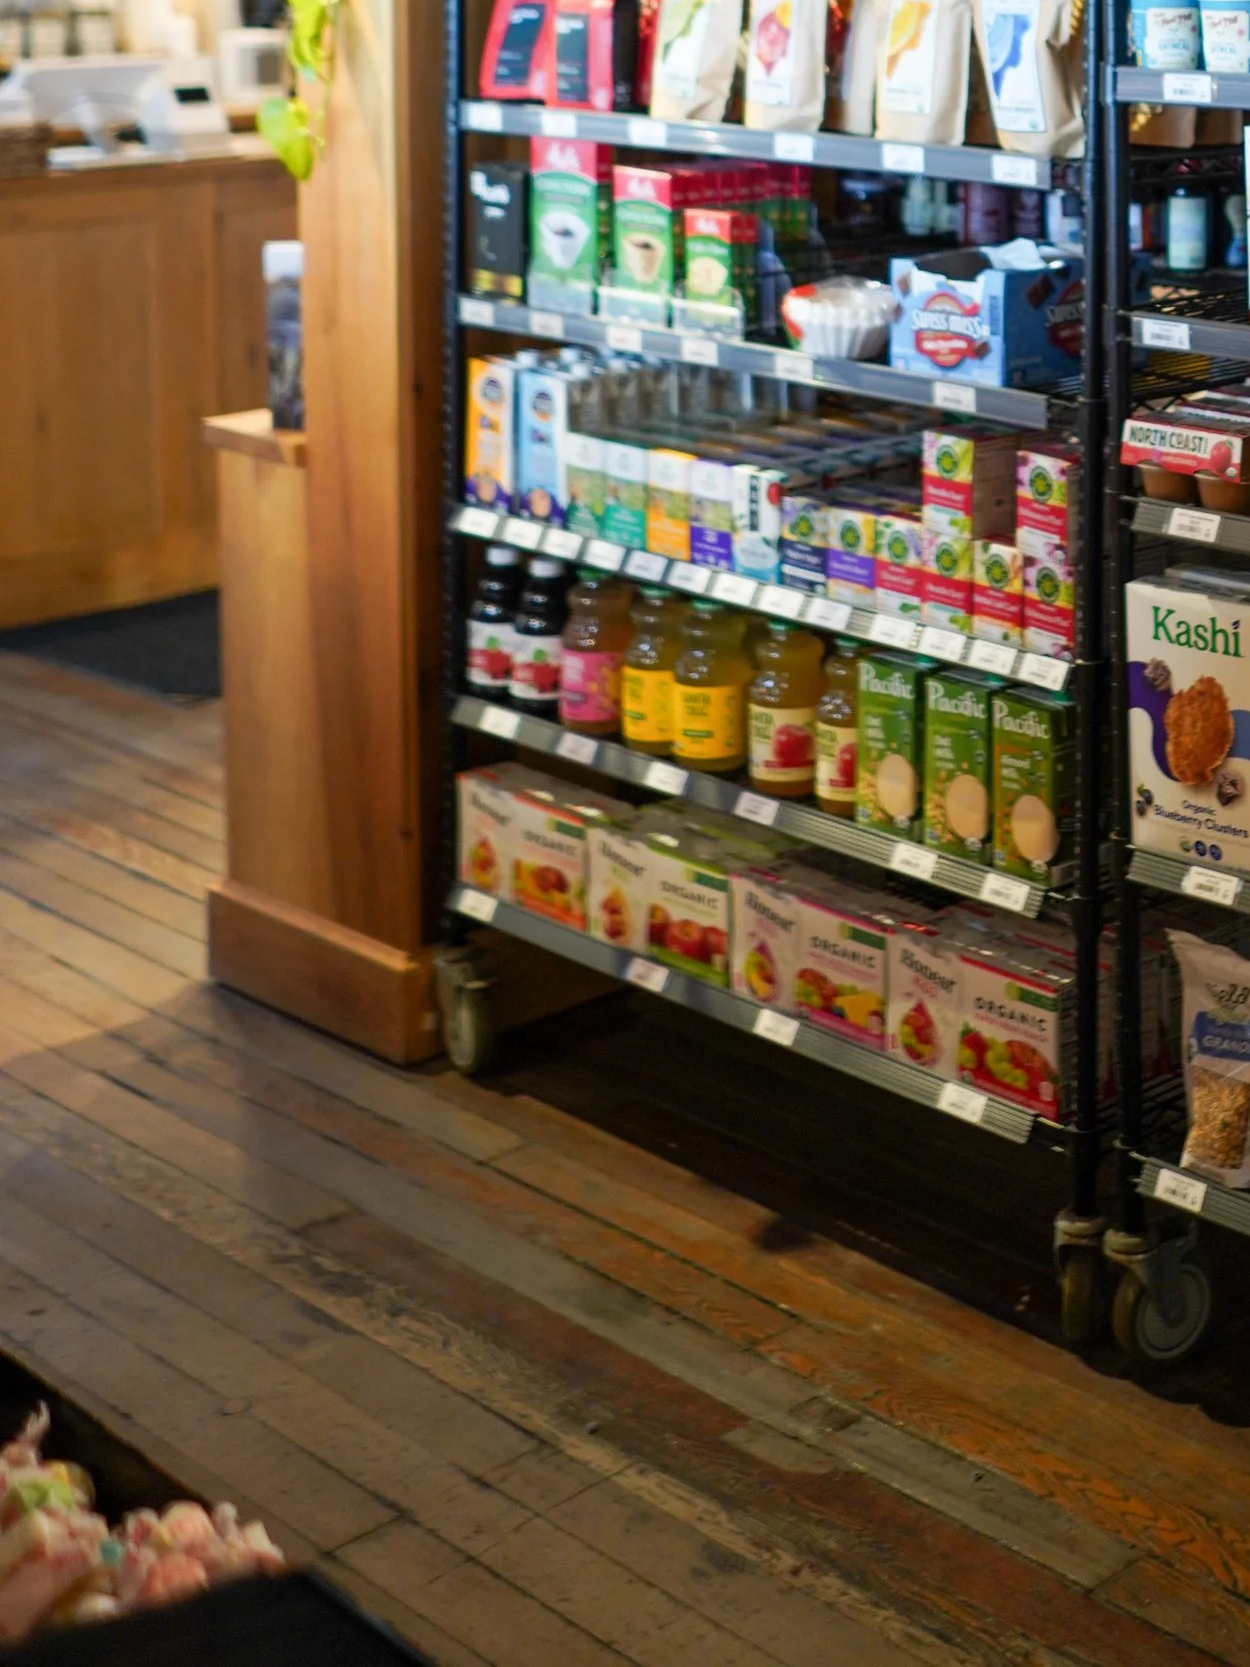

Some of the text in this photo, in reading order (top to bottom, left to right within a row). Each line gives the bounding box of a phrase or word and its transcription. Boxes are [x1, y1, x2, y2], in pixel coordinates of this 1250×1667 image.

[1129, 425, 1167, 450] NORTH
[1152, 604, 1244, 659] Kashi
[858, 659, 916, 700] Pacific
[925, 679, 988, 719] Pacific
[991, 697, 1051, 740] Pacific
[1153, 804, 1250, 838] Blueberry Clusters
[1181, 799, 1217, 818] Organic
[808, 936, 876, 970] ORGANIC
[972, 996, 1047, 1032] ORGANIC
